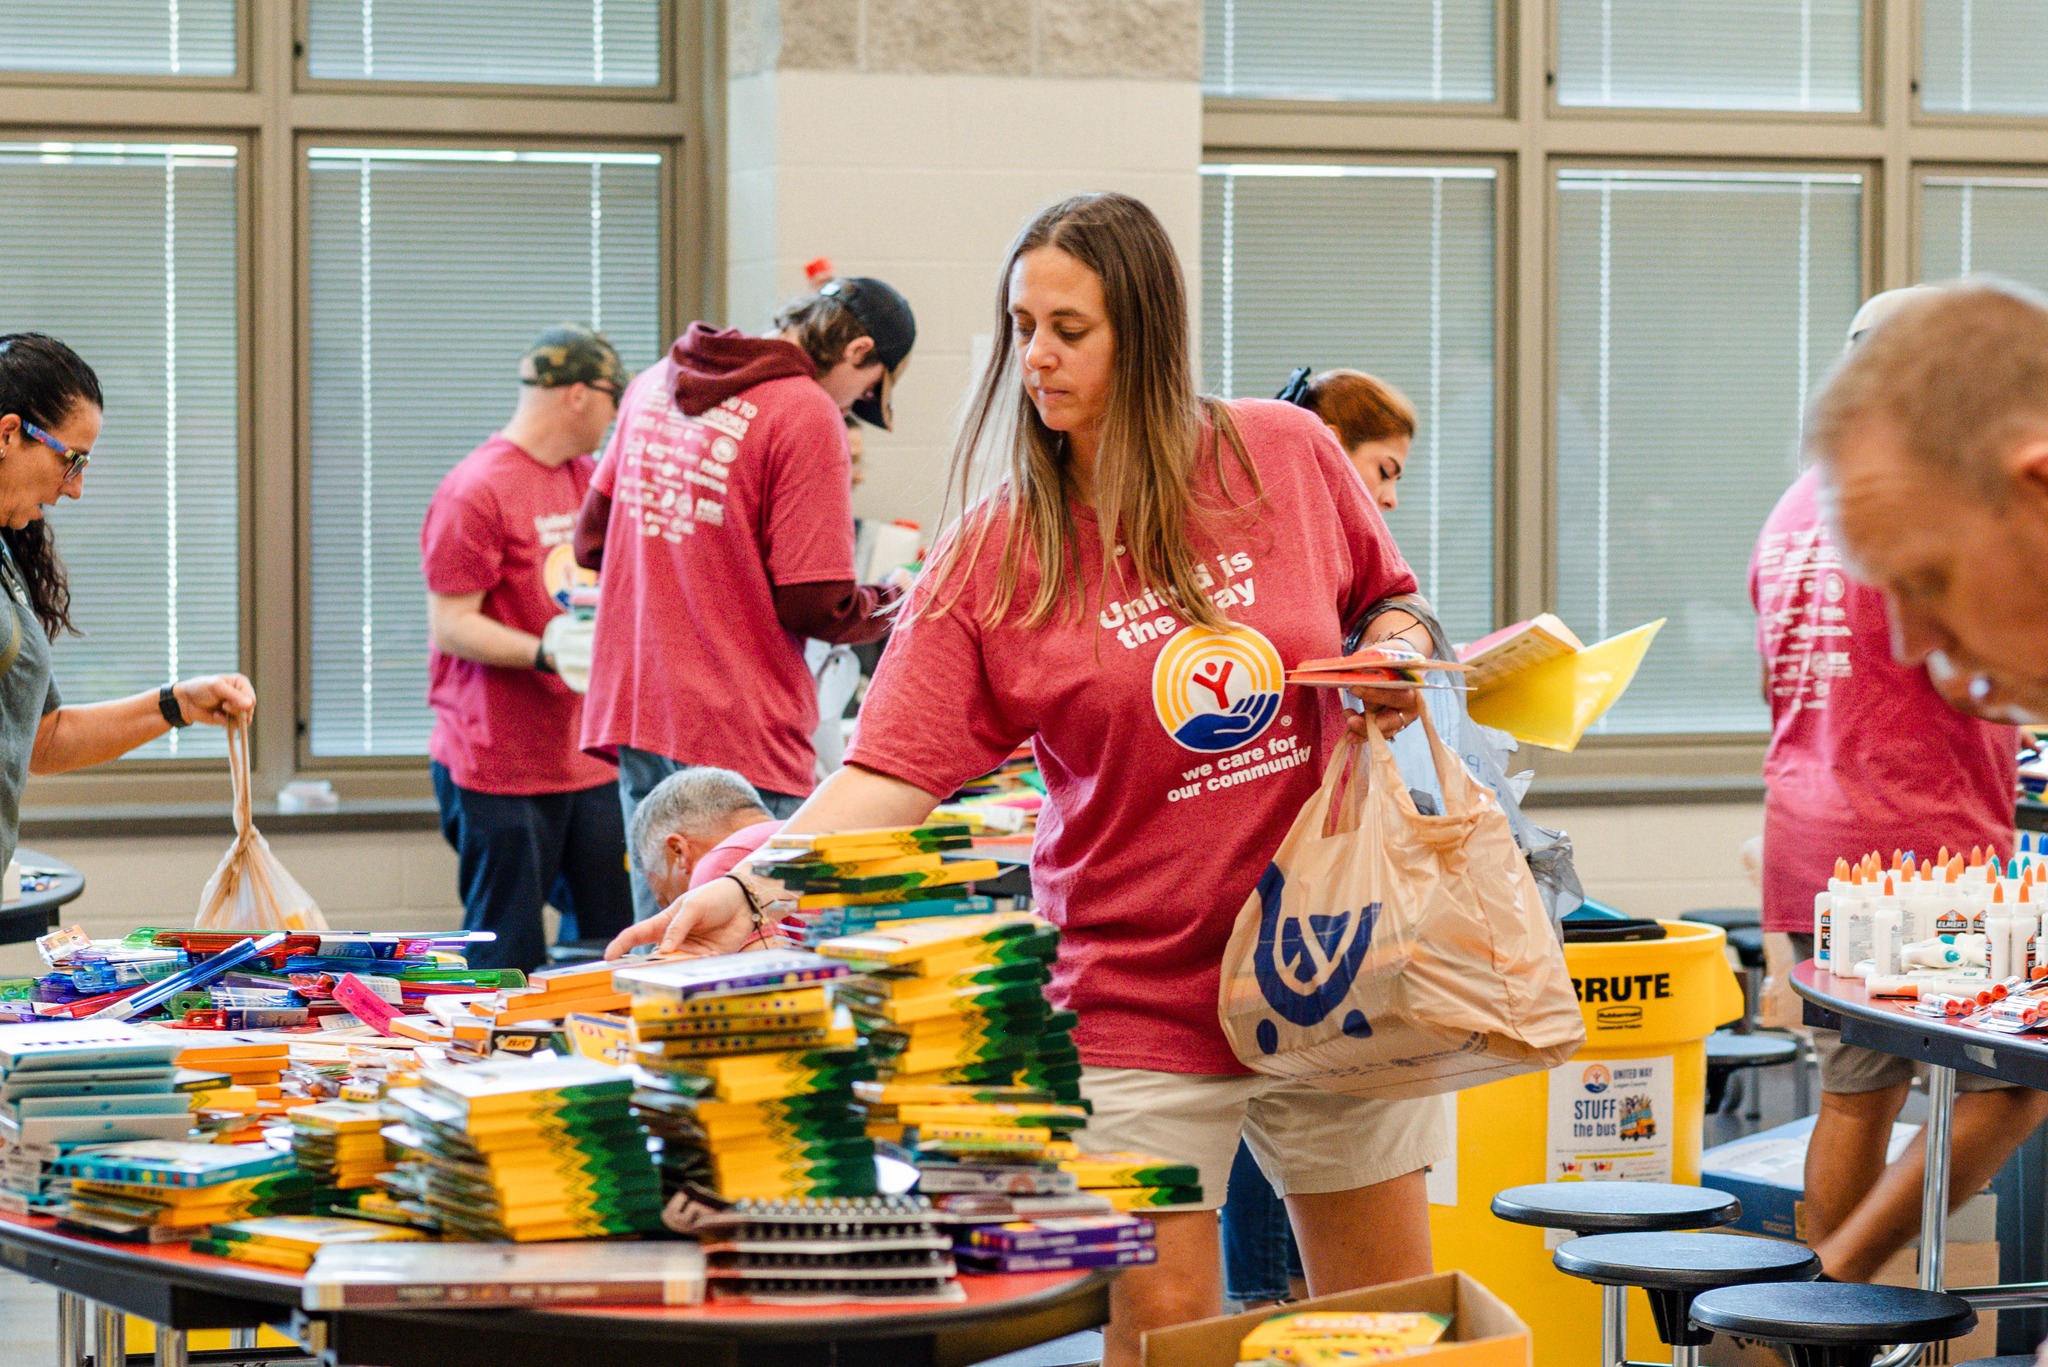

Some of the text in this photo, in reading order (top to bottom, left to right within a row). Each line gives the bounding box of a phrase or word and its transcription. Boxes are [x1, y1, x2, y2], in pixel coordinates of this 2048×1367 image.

[1099, 552, 1253, 629] Unitd is
[1117, 578, 1256, 649] the ay
[1167, 746, 1312, 802] our community
[1182, 735, 1297, 781] we care for
[1613, 1067, 1653, 1080] UNITED WAY
[1573, 1098, 1617, 1120] STUFF
[1573, 1122, 1617, 1137] the bus
